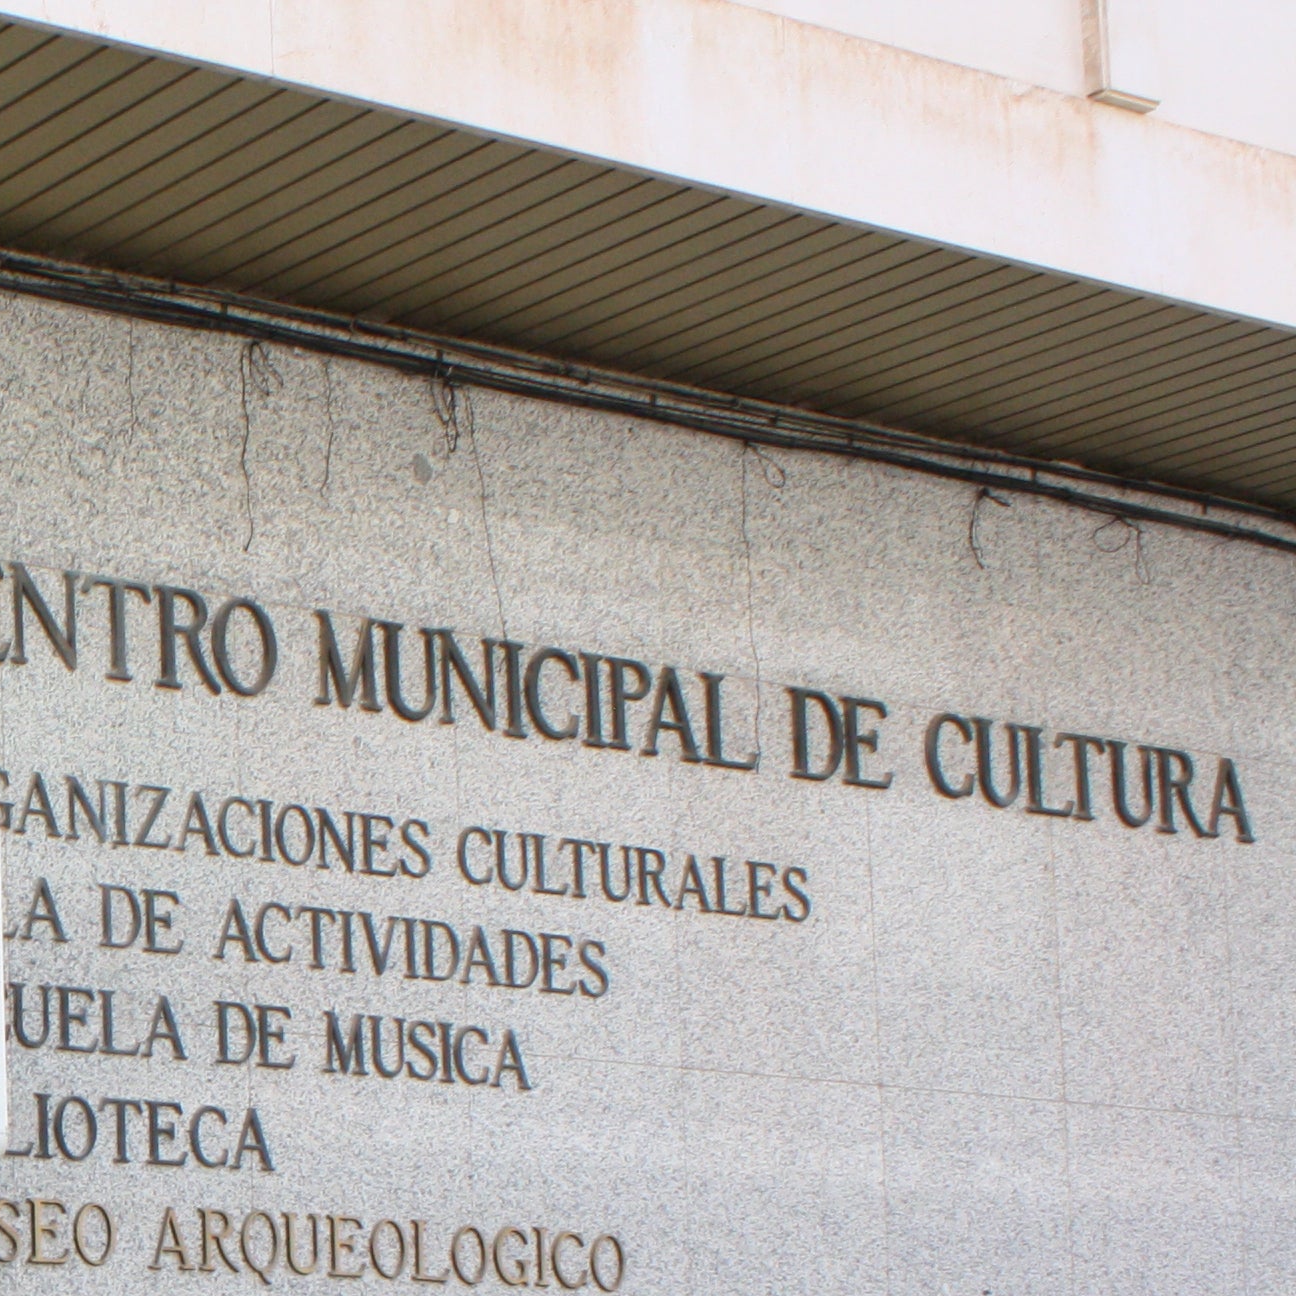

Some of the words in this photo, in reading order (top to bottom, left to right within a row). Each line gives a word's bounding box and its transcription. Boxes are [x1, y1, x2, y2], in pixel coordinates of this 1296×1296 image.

[314, 607, 762, 773] MUNICIPAL
[784, 685, 894, 790] DE
[924, 711, 1257, 845] CULTURA
[456, 825, 812, 924] CULTURALES
[99, 883, 185, 956] DE
[213, 898, 610, 999] ACTIVIDADES
[5, 982, 189, 1062] UELA
[214, 999, 297, 1071] DE
[323, 1008, 533, 1091] MUSICA
[5, 1092, 276, 1172] IOTECA
[148, 1207, 627, 1293] ARQUEOLOGICO
